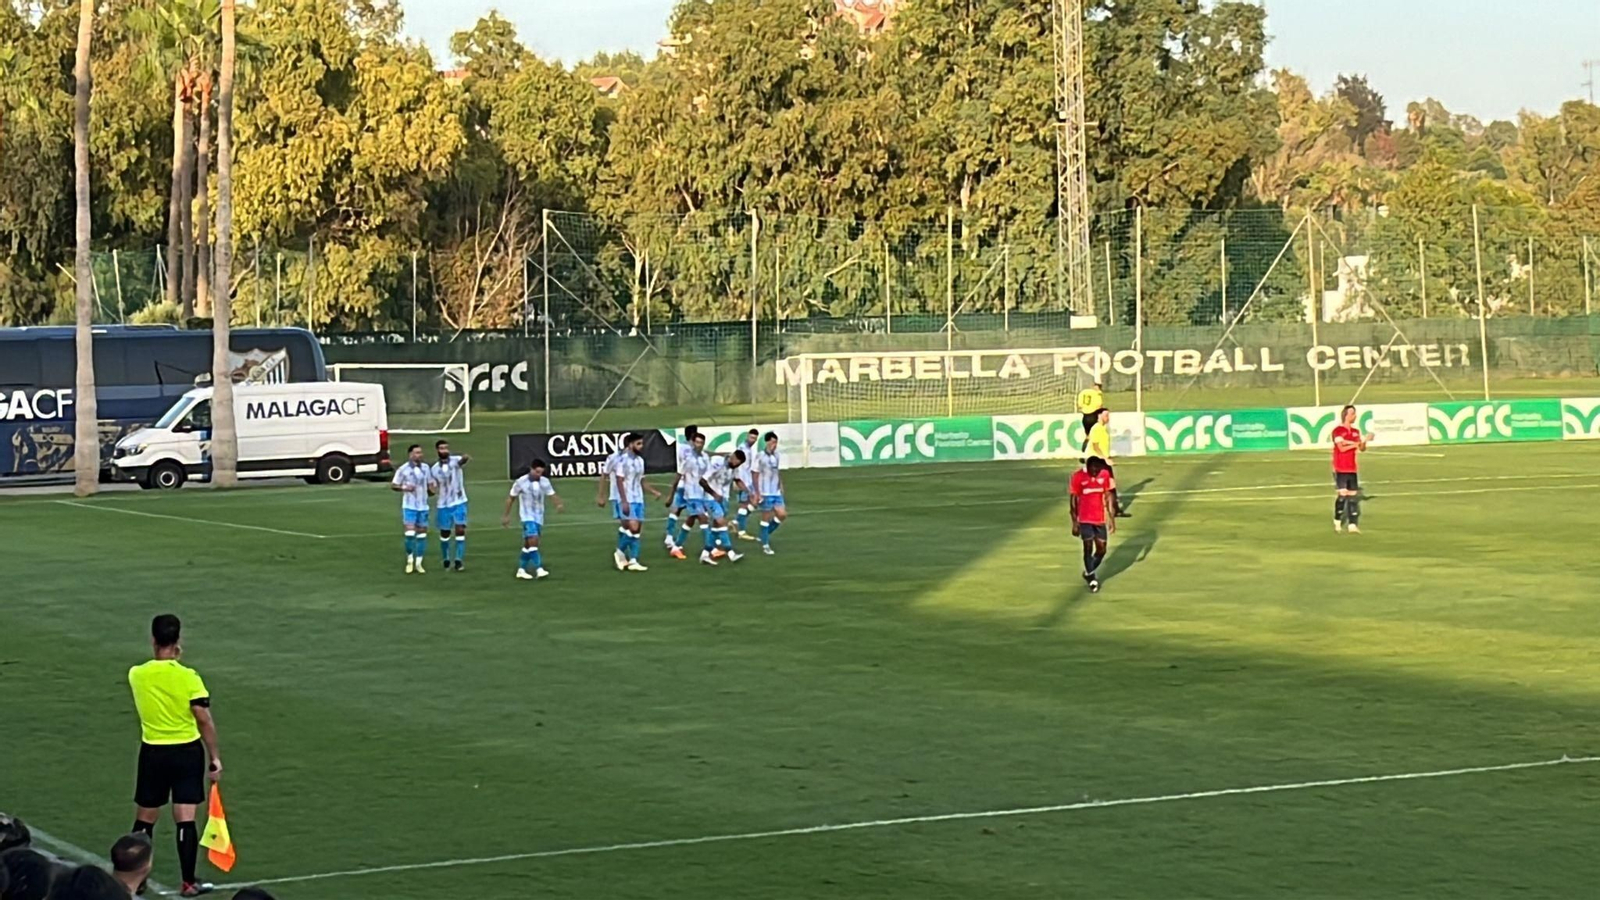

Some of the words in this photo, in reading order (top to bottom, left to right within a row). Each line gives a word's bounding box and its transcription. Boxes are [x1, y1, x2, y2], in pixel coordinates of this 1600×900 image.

[775, 353, 1031, 386] MARBELLA
[1053, 346, 1284, 376] FOOTBALL
[1306, 342, 1471, 371] CENTER
[246, 397, 366, 419] MALAGACF
